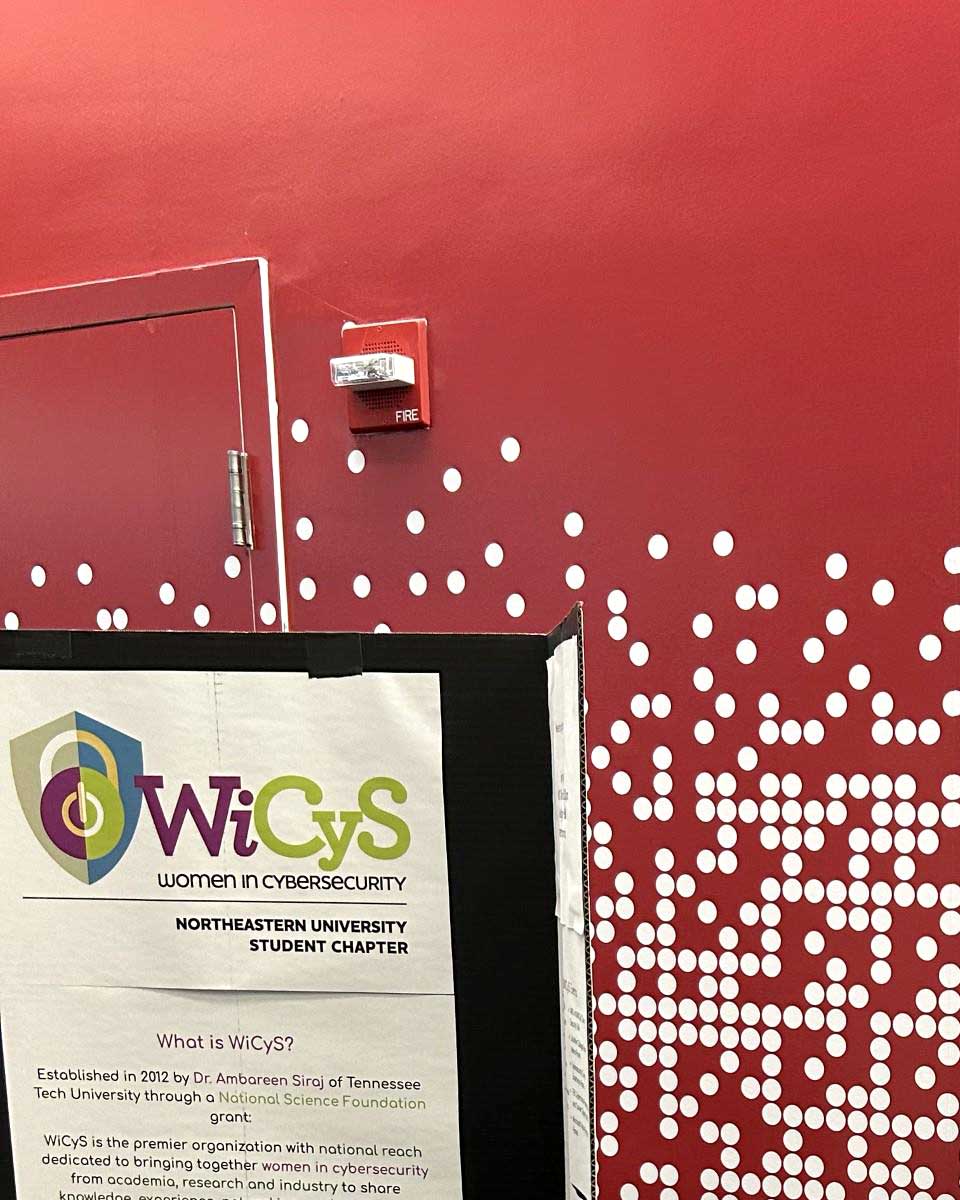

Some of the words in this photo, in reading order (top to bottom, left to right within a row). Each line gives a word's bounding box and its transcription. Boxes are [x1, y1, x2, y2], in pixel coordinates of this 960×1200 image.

[396, 409, 420, 422] FIRE
[134, 775, 411, 871] WiCyS
[176, 918, 307, 932] NORTHEASTERN
[311, 919, 407, 934] UNIVERSITY
[249, 939, 326, 952] STUDENT
[331, 940, 409, 954] CHAPTER
[157, 1033, 204, 1049] What
[210, 1035, 224, 1049] is
[228, 1035, 293, 1055] WiCyS?
[37, 1068, 119, 1082] Established
[124, 1070, 136, 1082] in
[141, 1070, 169, 1083] 2012
[173, 1071, 189, 1086] by
[194, 1072, 212, 1084] Dr.
[216, 1072, 288, 1086] Ambareen
[292, 1074, 324, 1089] Siraj
[329, 1076, 343, 1088] of
[346, 1076, 421, 1090] Tennessee
[33, 1087, 66, 1099] Tech
[71, 1088, 140, 1103] University
[144, 1089, 201, 1105] through
[206, 1094, 214, 1103] a
[219, 1091, 280, 1105] National
[284, 1093, 339, 1107] Science
[343, 1095, 426, 1109] Foundation
[209, 1110, 252, 1126] grant:
[44, 1135, 88, 1150] WiCyS
[92, 1136, 103, 1147] is
[106, 1137, 129, 1148] the
[134, 1138, 188, 1151] premier
[192, 1140, 282, 1154] organization
[286, 1142, 314, 1154] with
[319, 1143, 378, 1156] national
[382, 1146, 422, 1157] reach
[42, 1153, 111, 1166] dedicated
[115, 1156, 129, 1167] to
[134, 1156, 193, 1172] bringing
[197, 1158, 258, 1173] together
[262, 1163, 311, 1172] women
[316, 1161, 328, 1173] in
[332, 1162, 429, 1180] cybersecurity
[71, 1172, 103, 1184] from
[107, 1174, 178, 1189] academia,
[183, 1177, 243, 1189] research
[248, 1179, 275, 1190] and
[280, 1179, 338, 1194] industry
[342, 1182, 356, 1193] to
[361, 1182, 400, 1194] share
